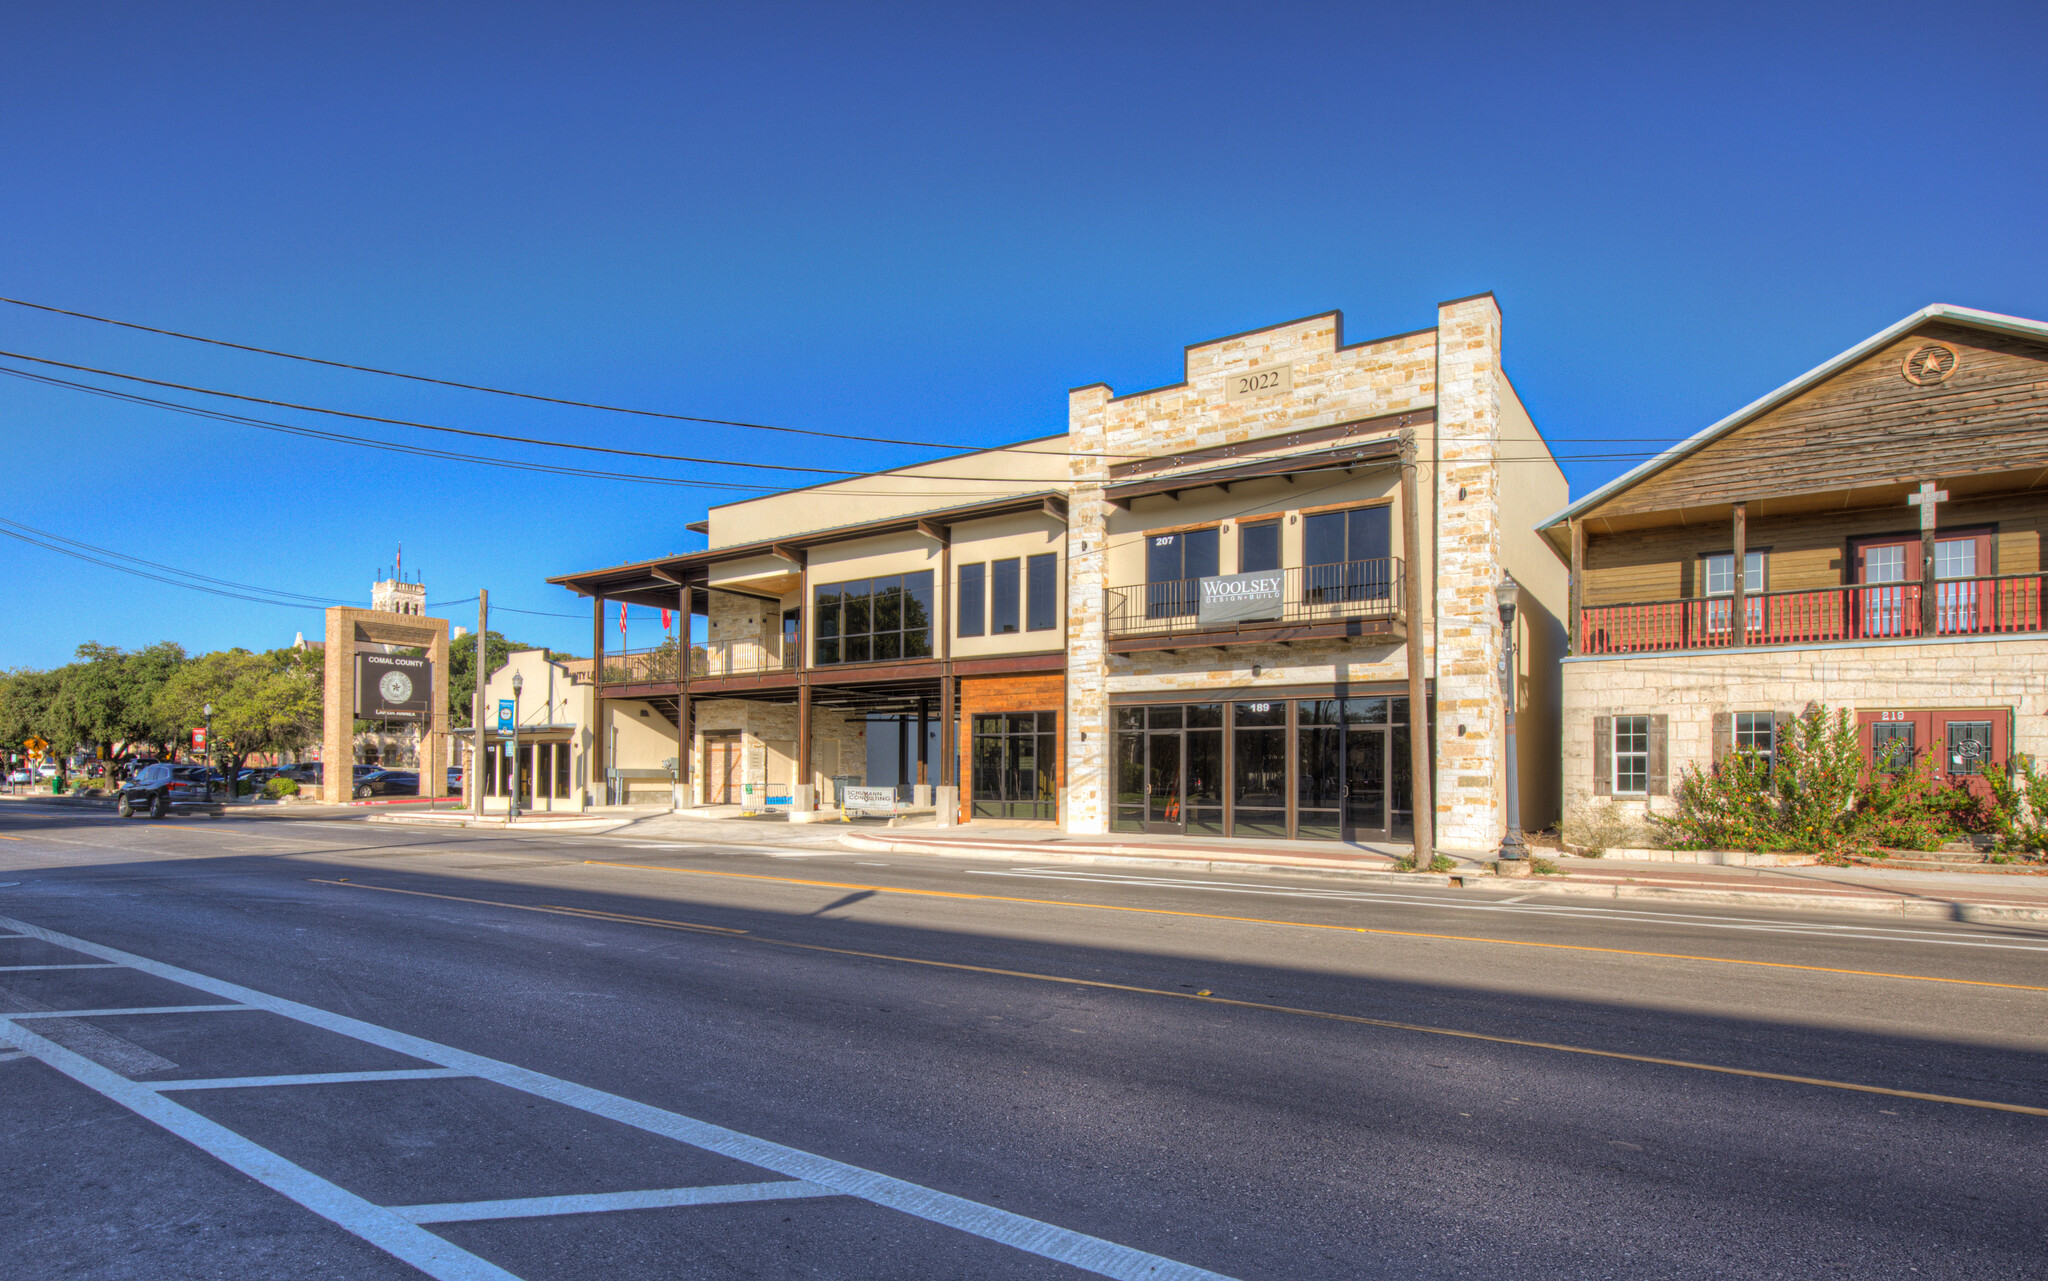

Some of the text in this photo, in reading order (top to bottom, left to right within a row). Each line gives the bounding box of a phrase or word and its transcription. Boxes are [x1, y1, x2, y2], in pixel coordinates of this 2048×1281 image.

[1239, 371, 1279, 394] 2022
[1156, 536, 1174, 546] 207
[1203, 577, 1281, 596] WOOLSEY
[368, 656, 424, 667] COMAL COUNTY
[1250, 703, 1270, 712] 189
